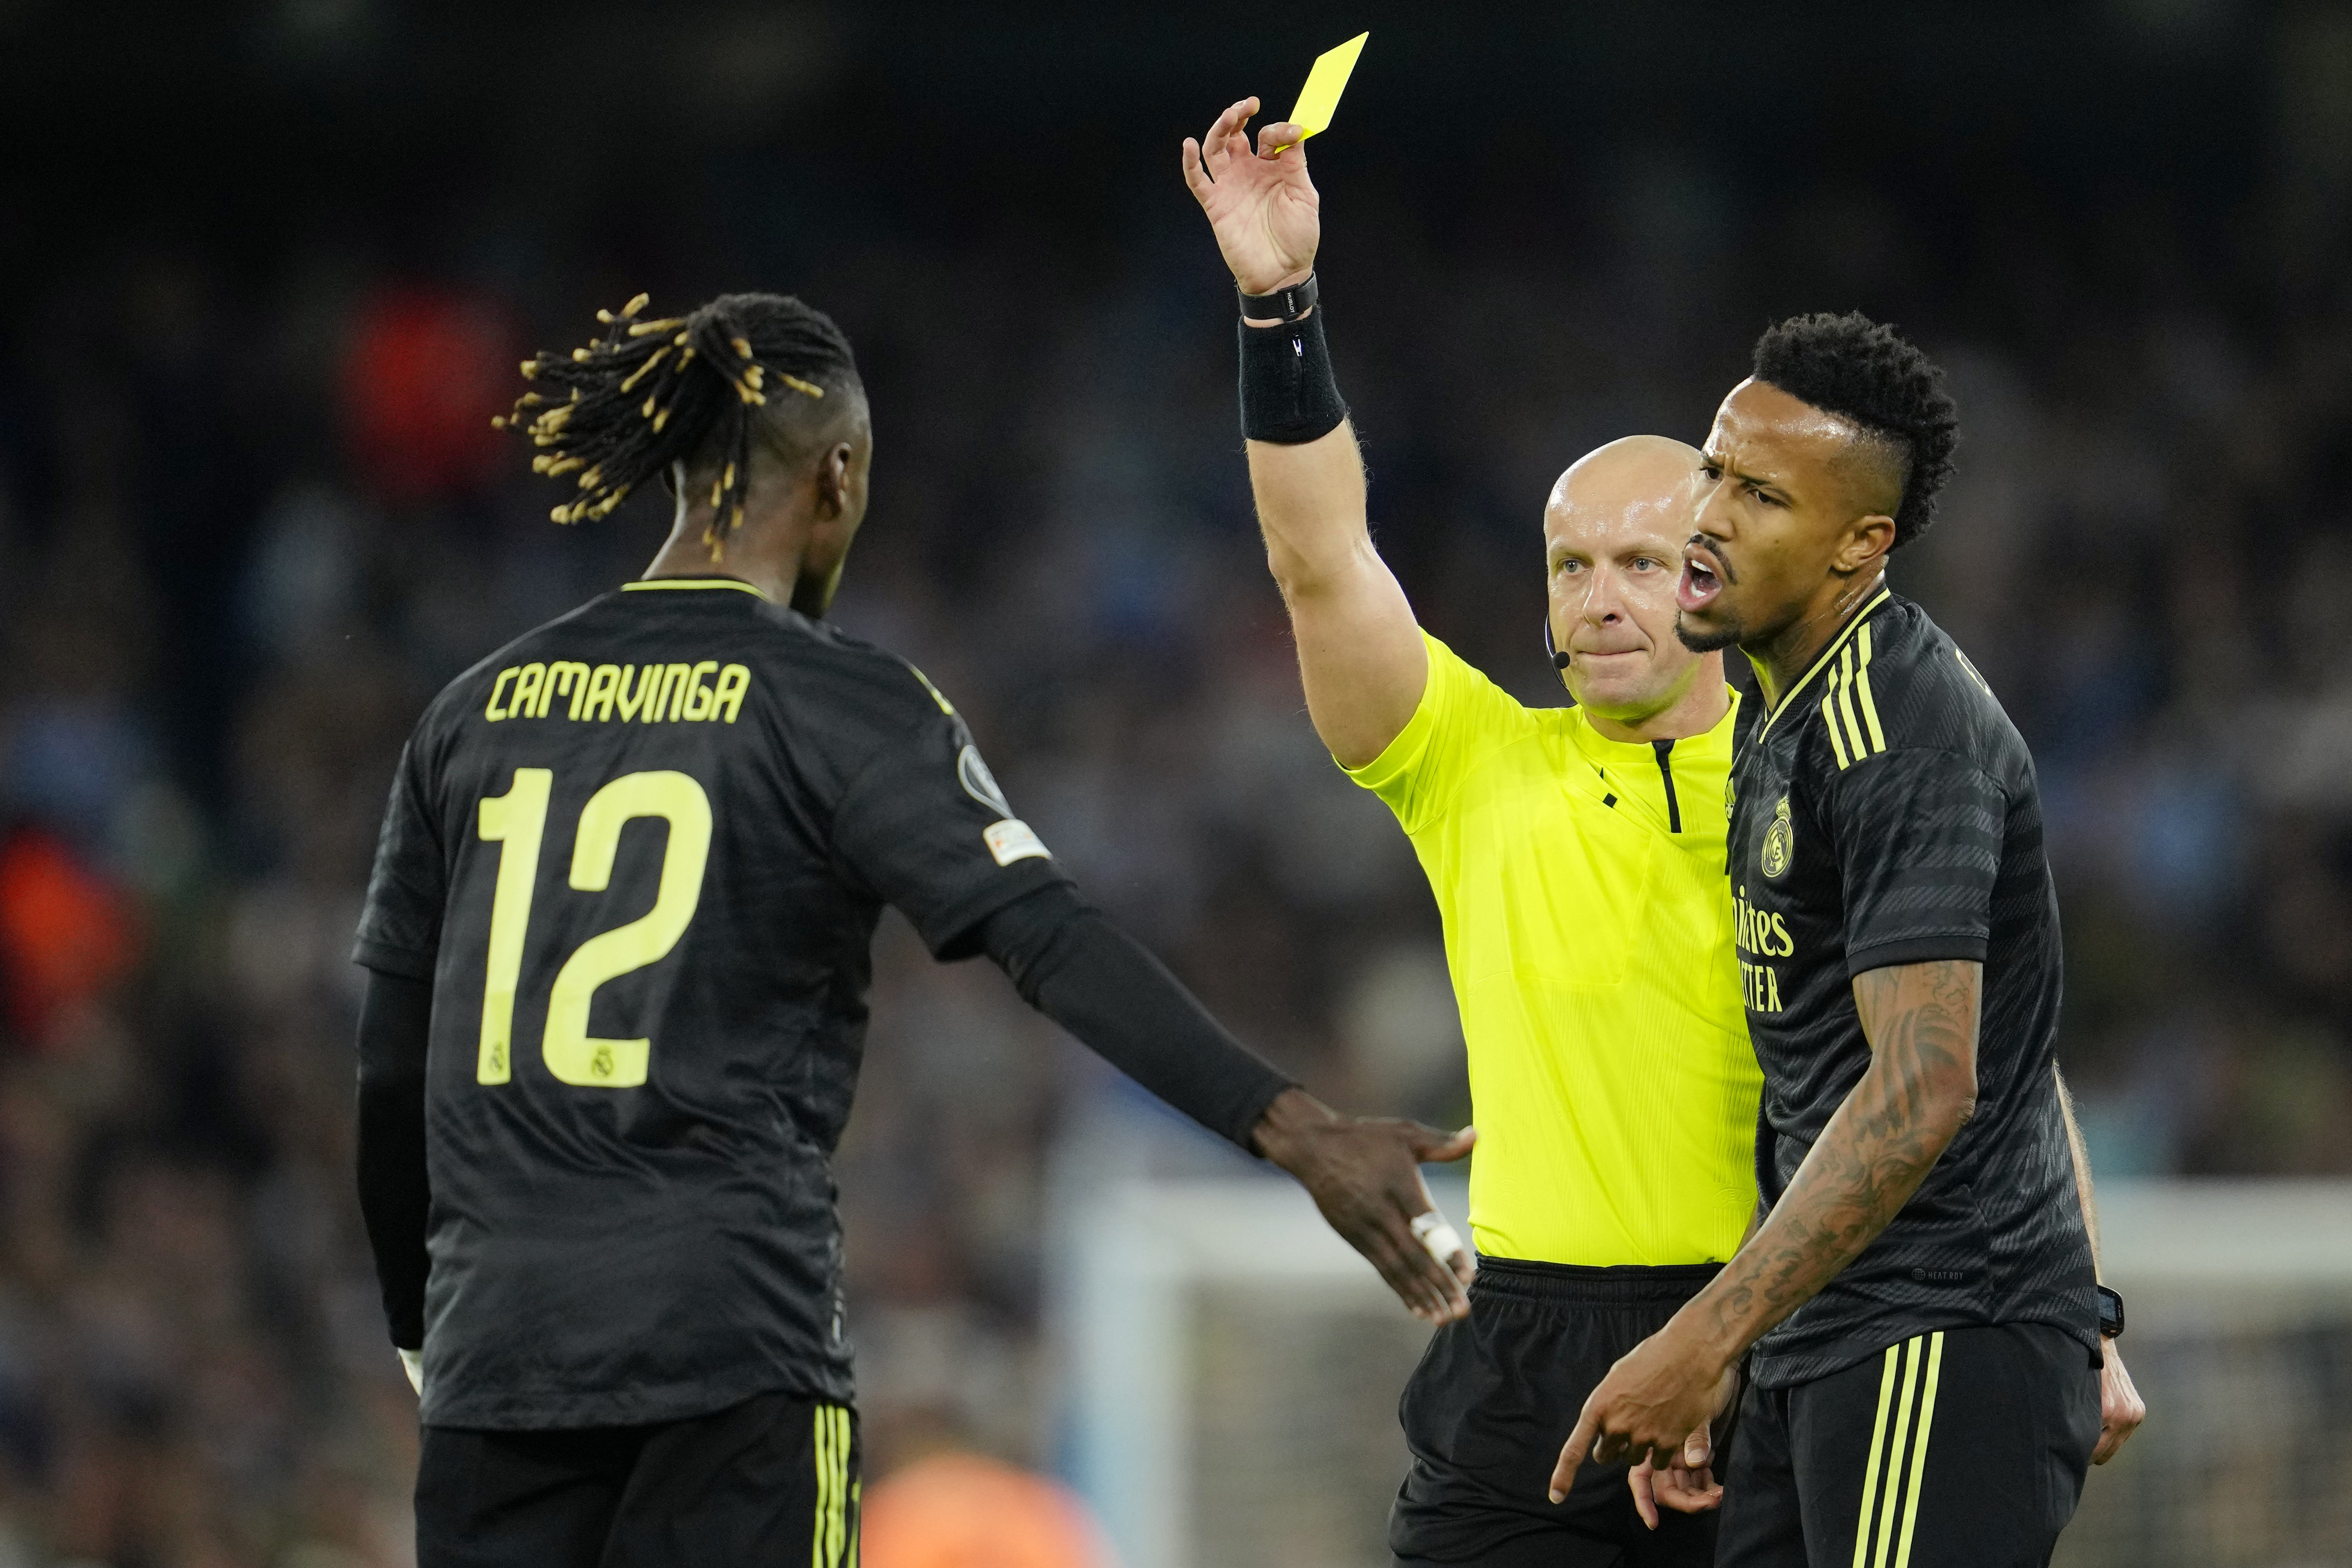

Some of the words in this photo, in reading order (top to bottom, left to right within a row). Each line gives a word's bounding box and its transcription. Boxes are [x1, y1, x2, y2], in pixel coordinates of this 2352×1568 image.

[485, 660, 751, 724] CAMAVINGA
[477, 767, 713, 1088] 12
[1732, 885, 1794, 957] ites
[1737, 958, 1783, 1012] ETTER
